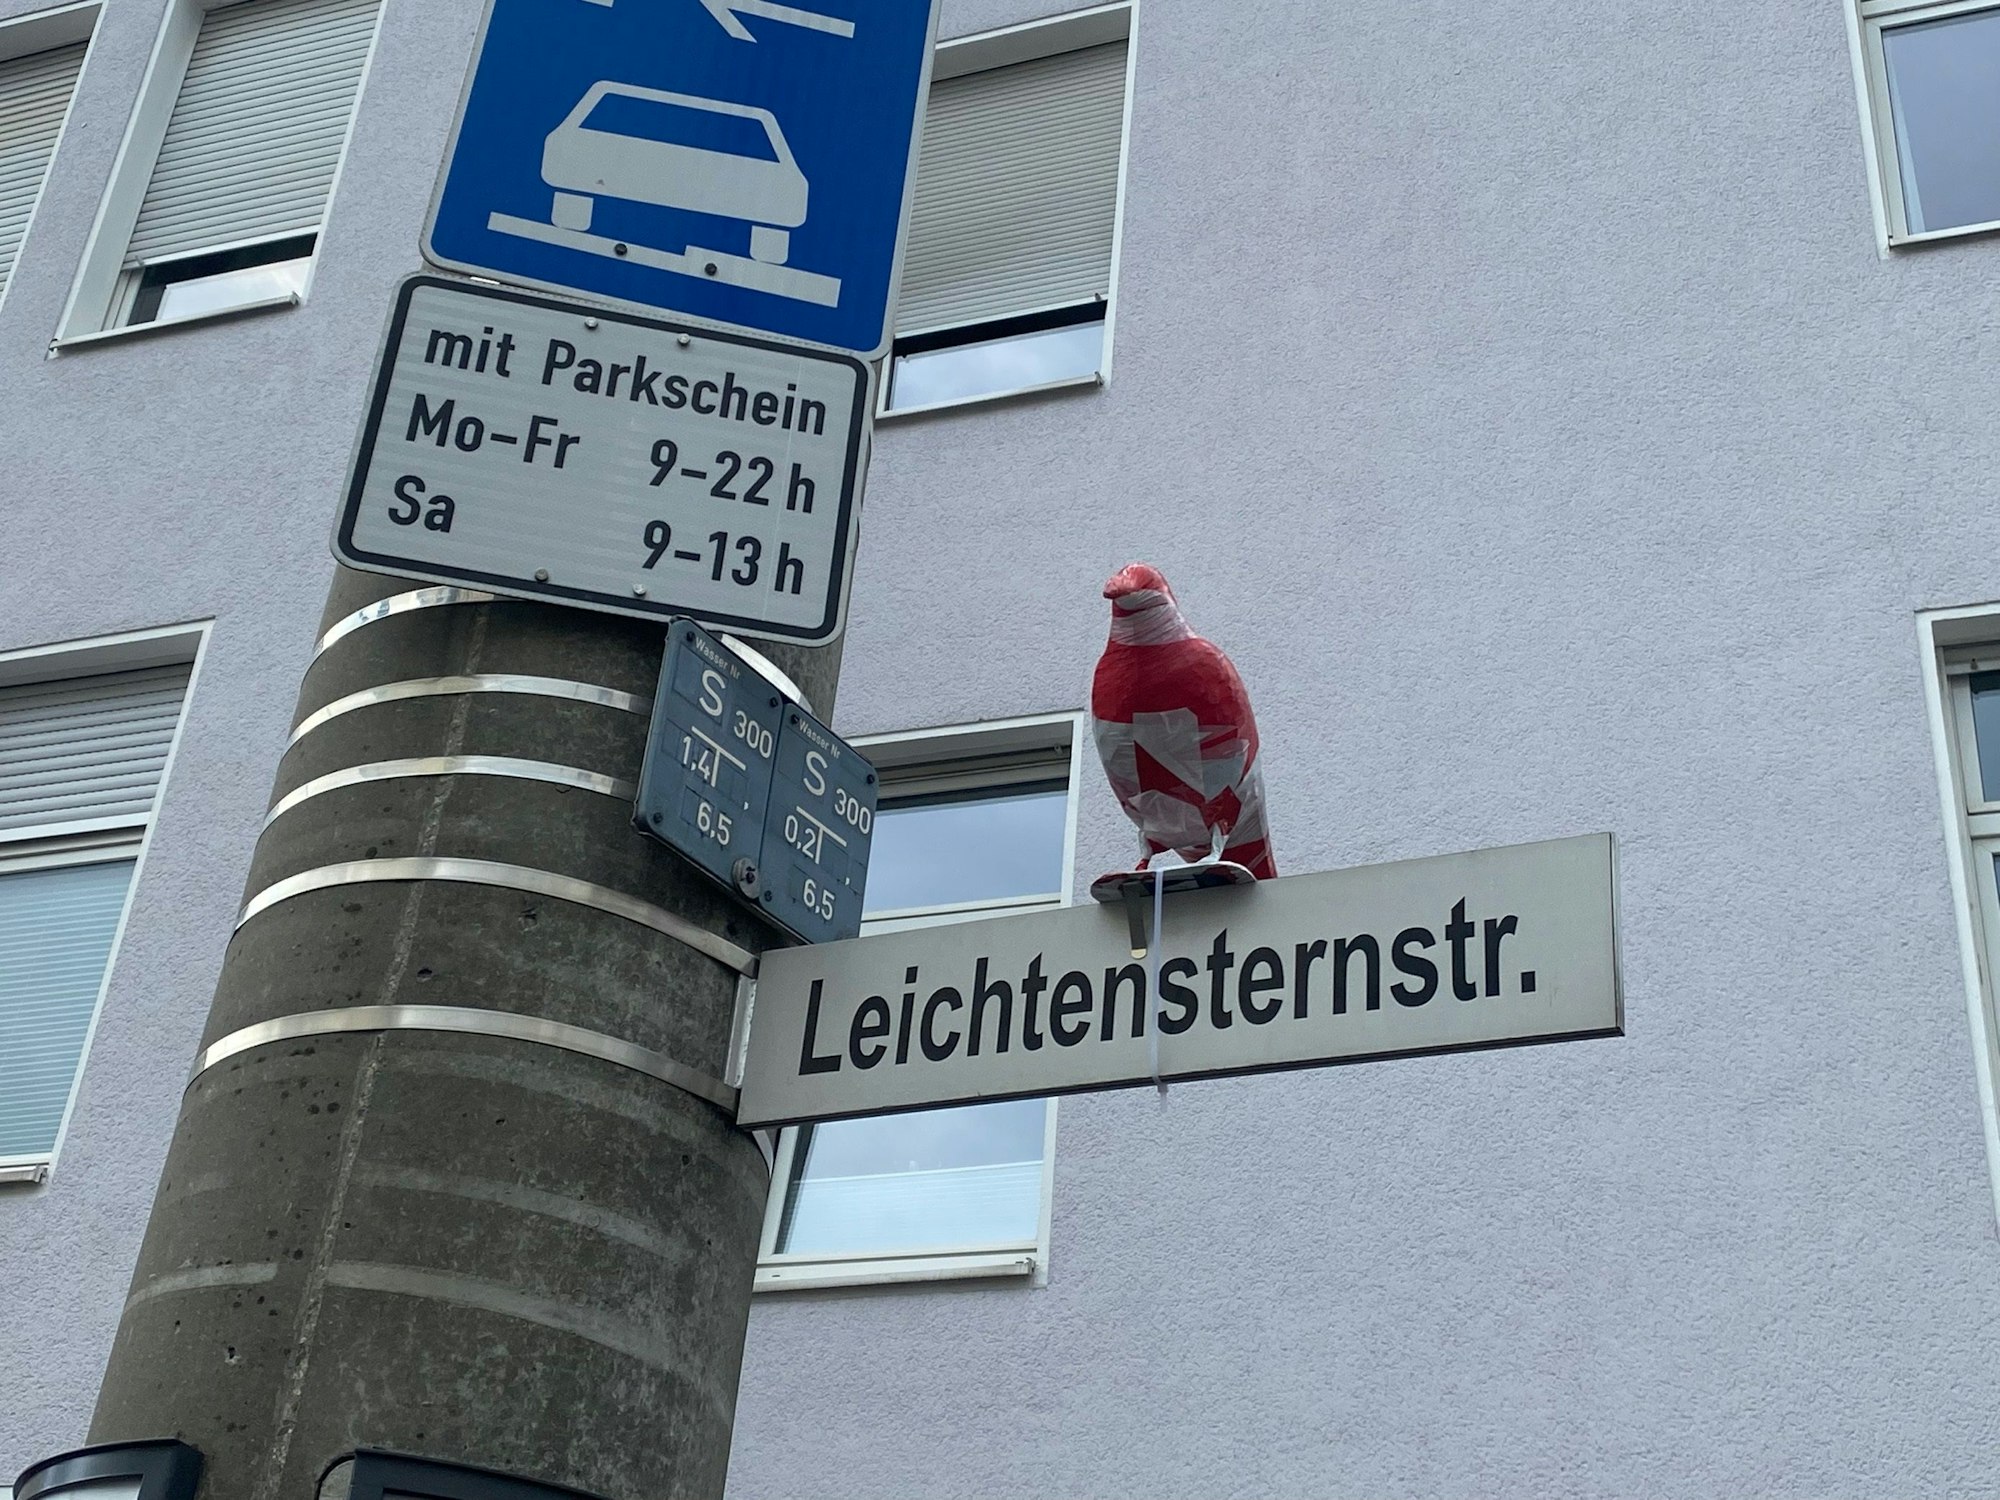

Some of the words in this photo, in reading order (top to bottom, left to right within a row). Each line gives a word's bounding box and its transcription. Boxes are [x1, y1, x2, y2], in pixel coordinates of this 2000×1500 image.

[425, 326, 515, 378] mit
[542, 339, 826, 435] Parkschein
[388, 475, 455, 533] Sa
[695, 637, 728, 670] Wasser
[699, 670, 726, 716] S
[734, 710, 773, 758] 300
[799, 718, 830, 750] Wasser
[803, 751, 828, 796] S
[834, 788, 871, 834] 300
[696, 802, 732, 845] 6,5
[803, 878, 835, 921] 6,5
[799, 896, 1538, 1076] Leichtensternstr.
